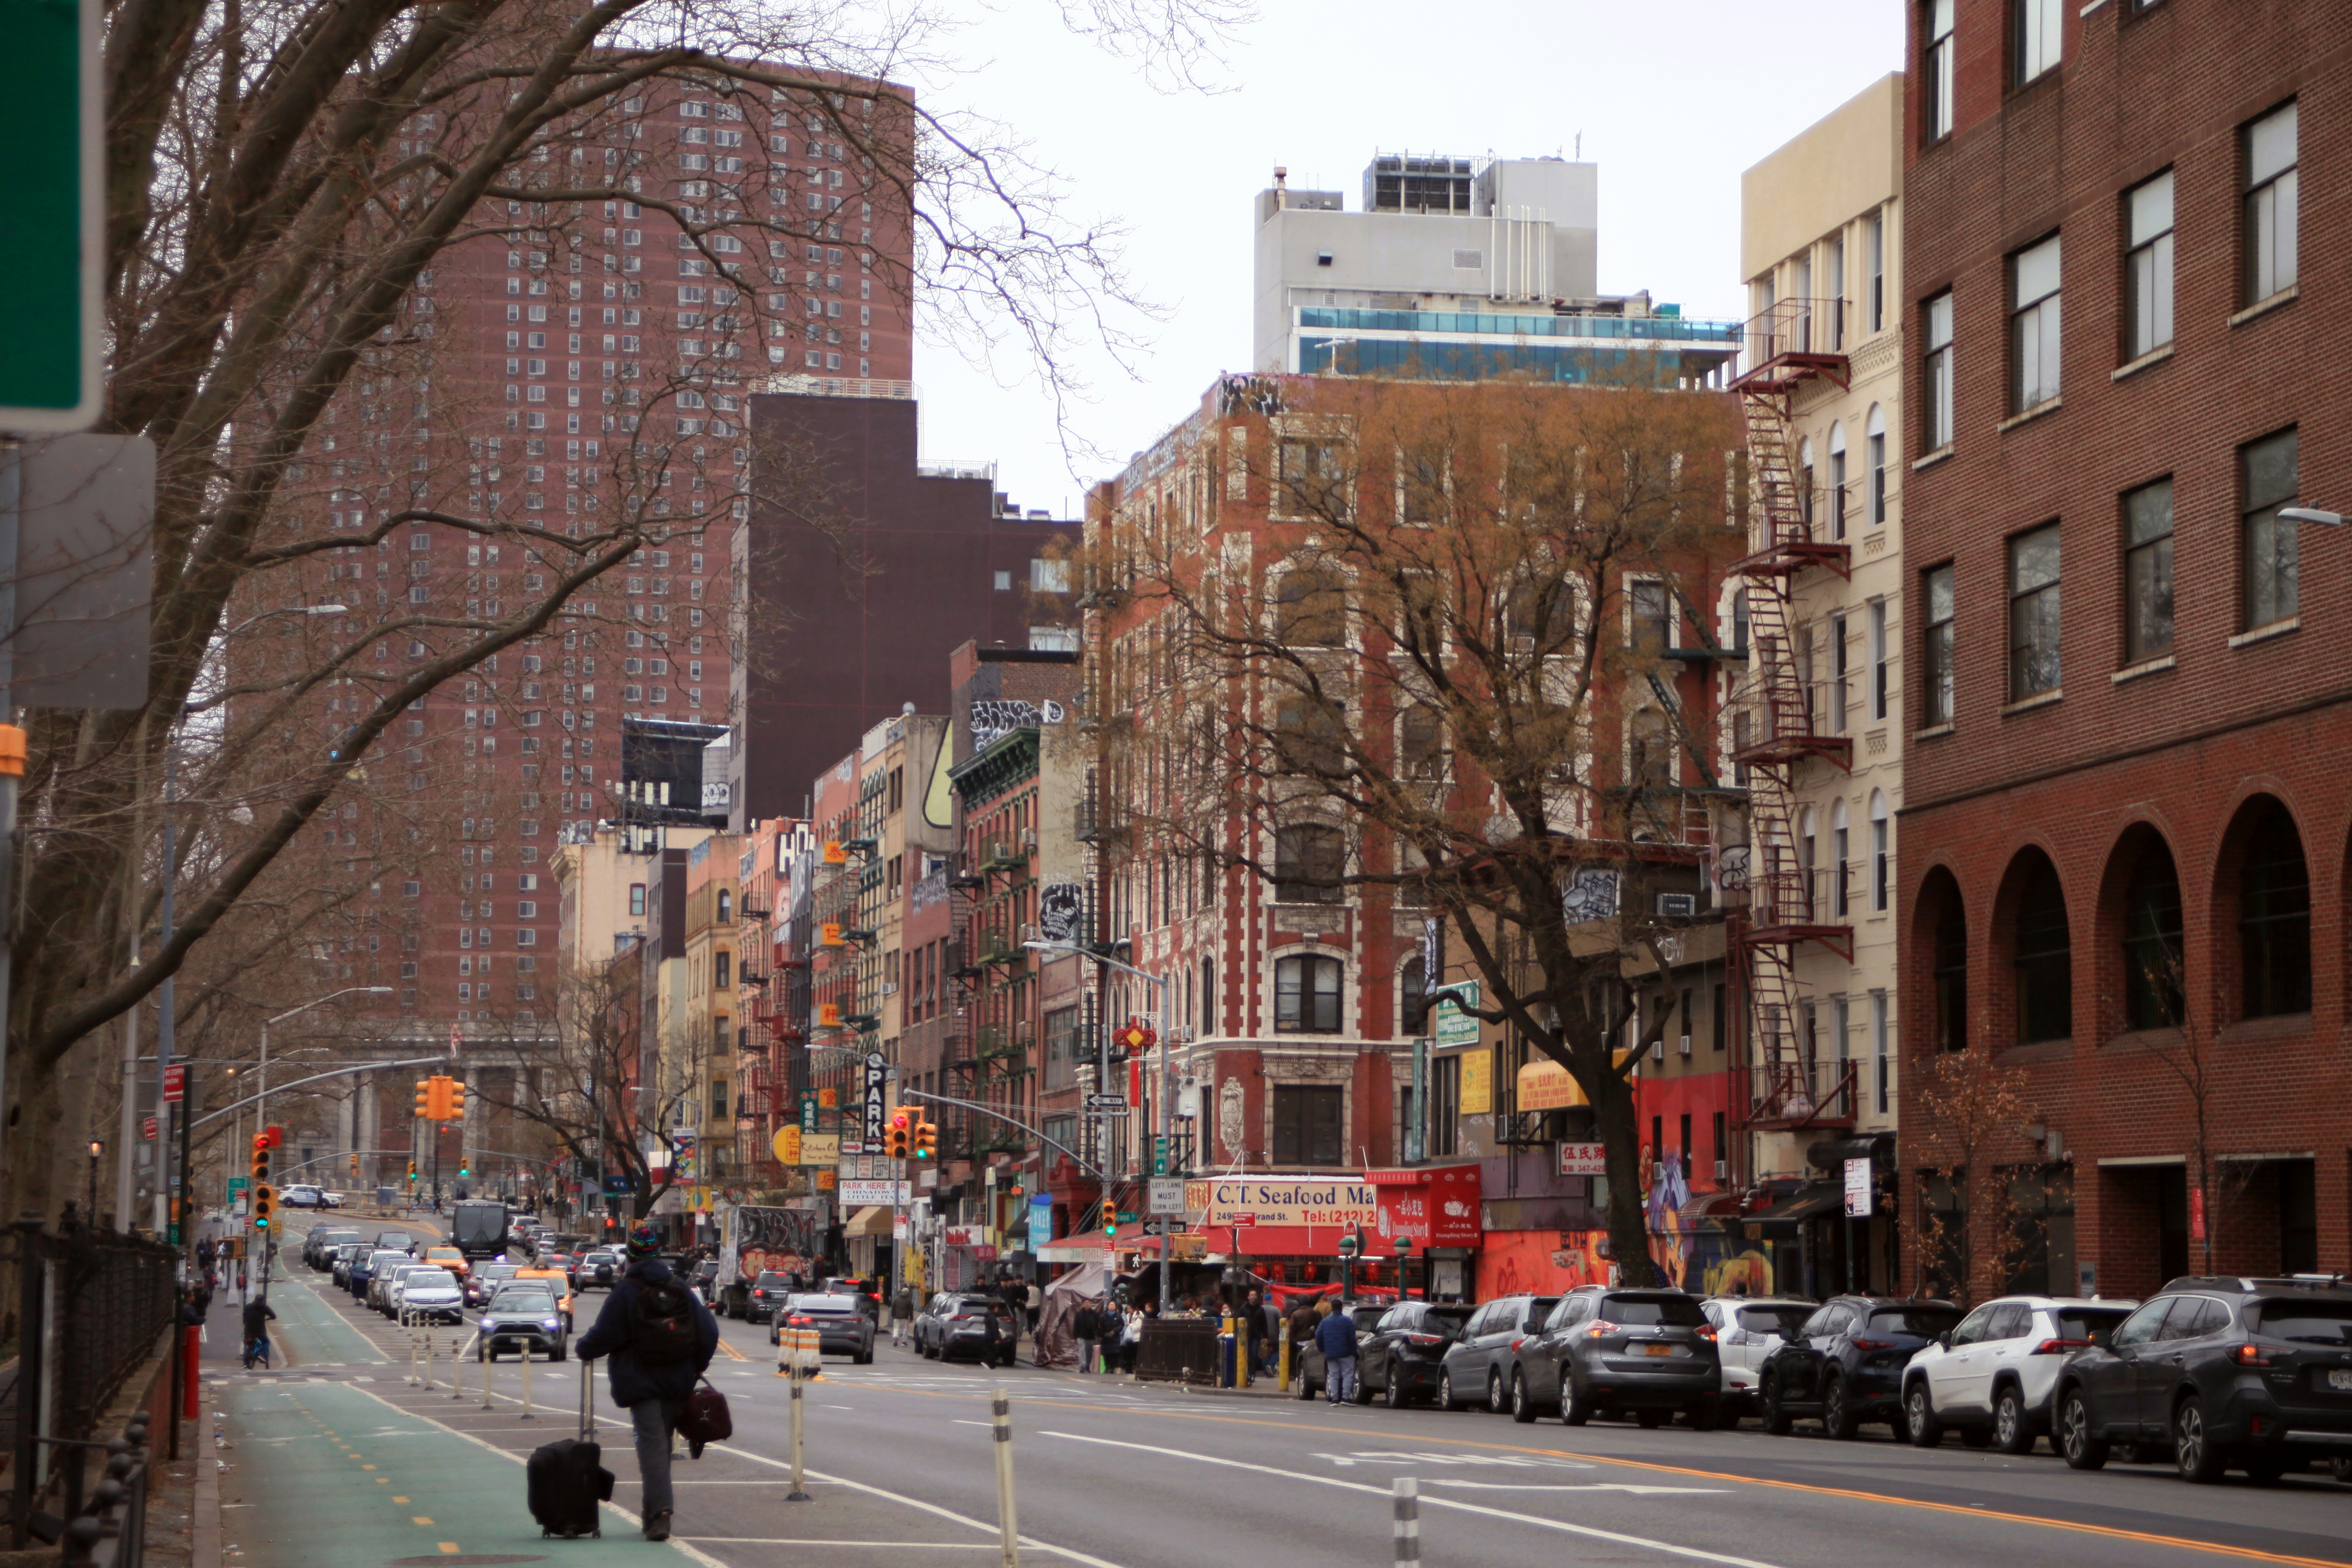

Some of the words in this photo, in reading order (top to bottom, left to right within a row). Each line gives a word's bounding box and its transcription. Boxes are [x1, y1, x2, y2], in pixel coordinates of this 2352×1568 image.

[867, 1070, 882, 1137] PARK
[801, 1141, 825, 1152] Kitchen
[1217, 1186, 1251, 1204] C.T.
[1259, 1186, 1336, 1204] Seafood
[1302, 1210, 1326, 1222] Tel:
[1330, 1210, 1363, 1223] (212)
[1393, 1220, 1413, 1240] Dumpling
[1413, 1222, 1425, 1240] Story
